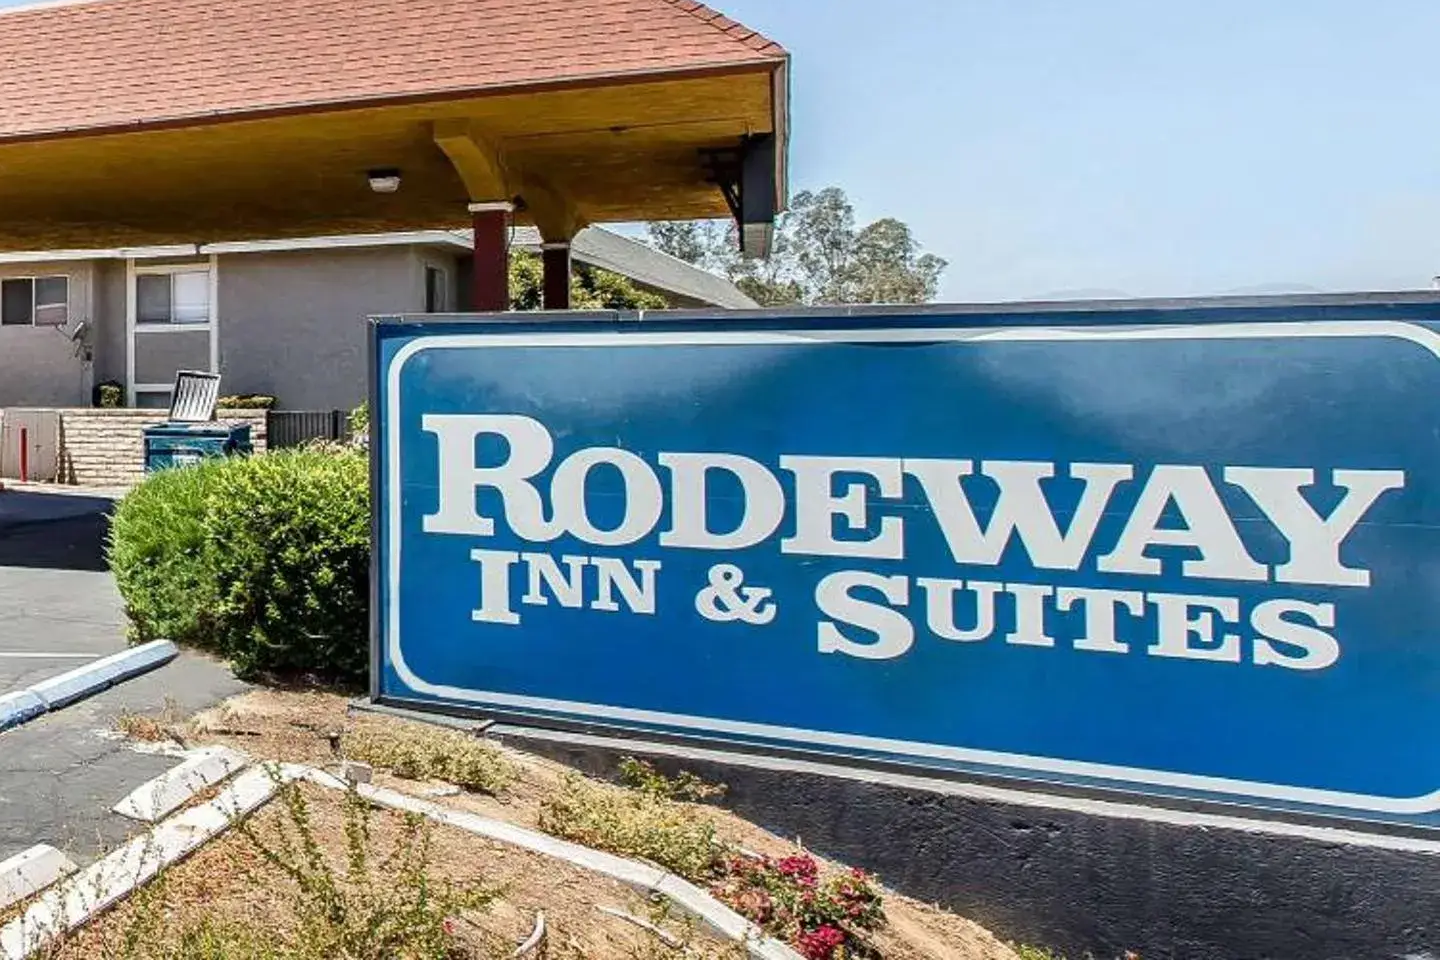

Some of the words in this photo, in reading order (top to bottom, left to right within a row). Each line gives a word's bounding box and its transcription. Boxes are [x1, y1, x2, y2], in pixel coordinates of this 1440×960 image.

[421, 413, 1406, 588] RODEWAY
[470, 548, 662, 626] INN
[694, 563, 778, 625] &
[815, 570, 1341, 671] SUITES
